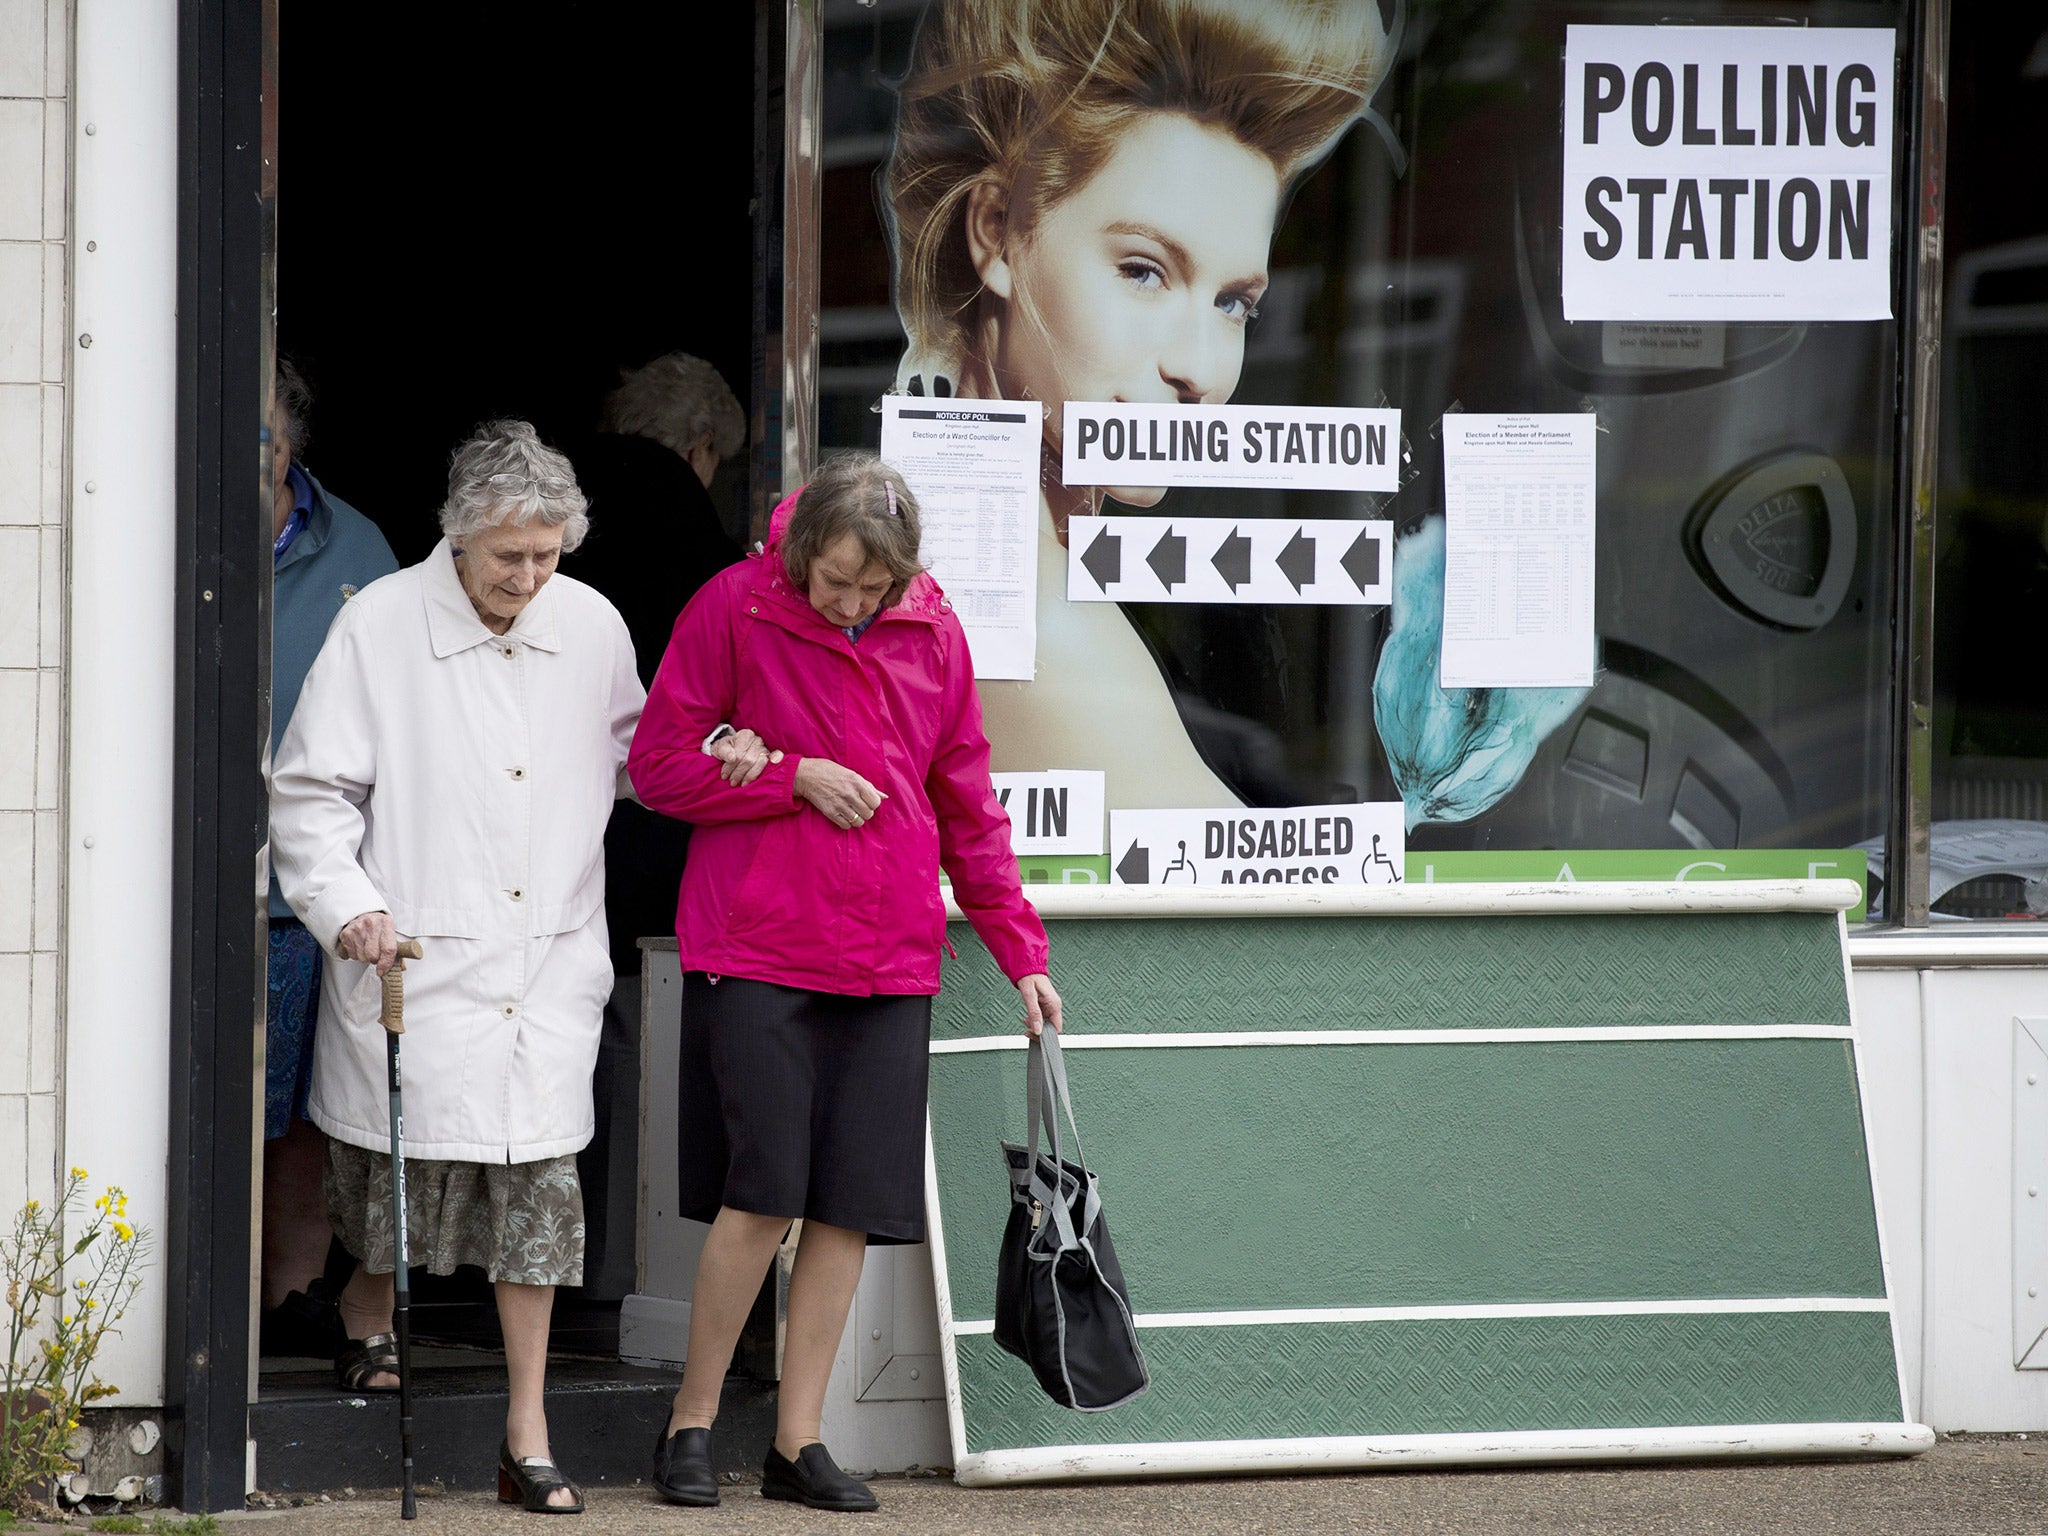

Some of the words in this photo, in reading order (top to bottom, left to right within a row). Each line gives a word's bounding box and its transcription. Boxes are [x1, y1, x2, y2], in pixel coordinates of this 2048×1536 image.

[1582, 61, 1876, 148] POLLING
[1583, 176, 1871, 262] STATION
[935, 412, 961, 420] NOTICE
[961, 413, 971, 421] OF
[1001, 434, 1011, 442] for
[1077, 418, 1228, 462] POLLING
[1243, 420, 1386, 466] STATION
[1737, 493, 1798, 535] DELTA
[1026, 787, 1068, 837] IN
[1205, 816, 1353, 859] DISABLED
